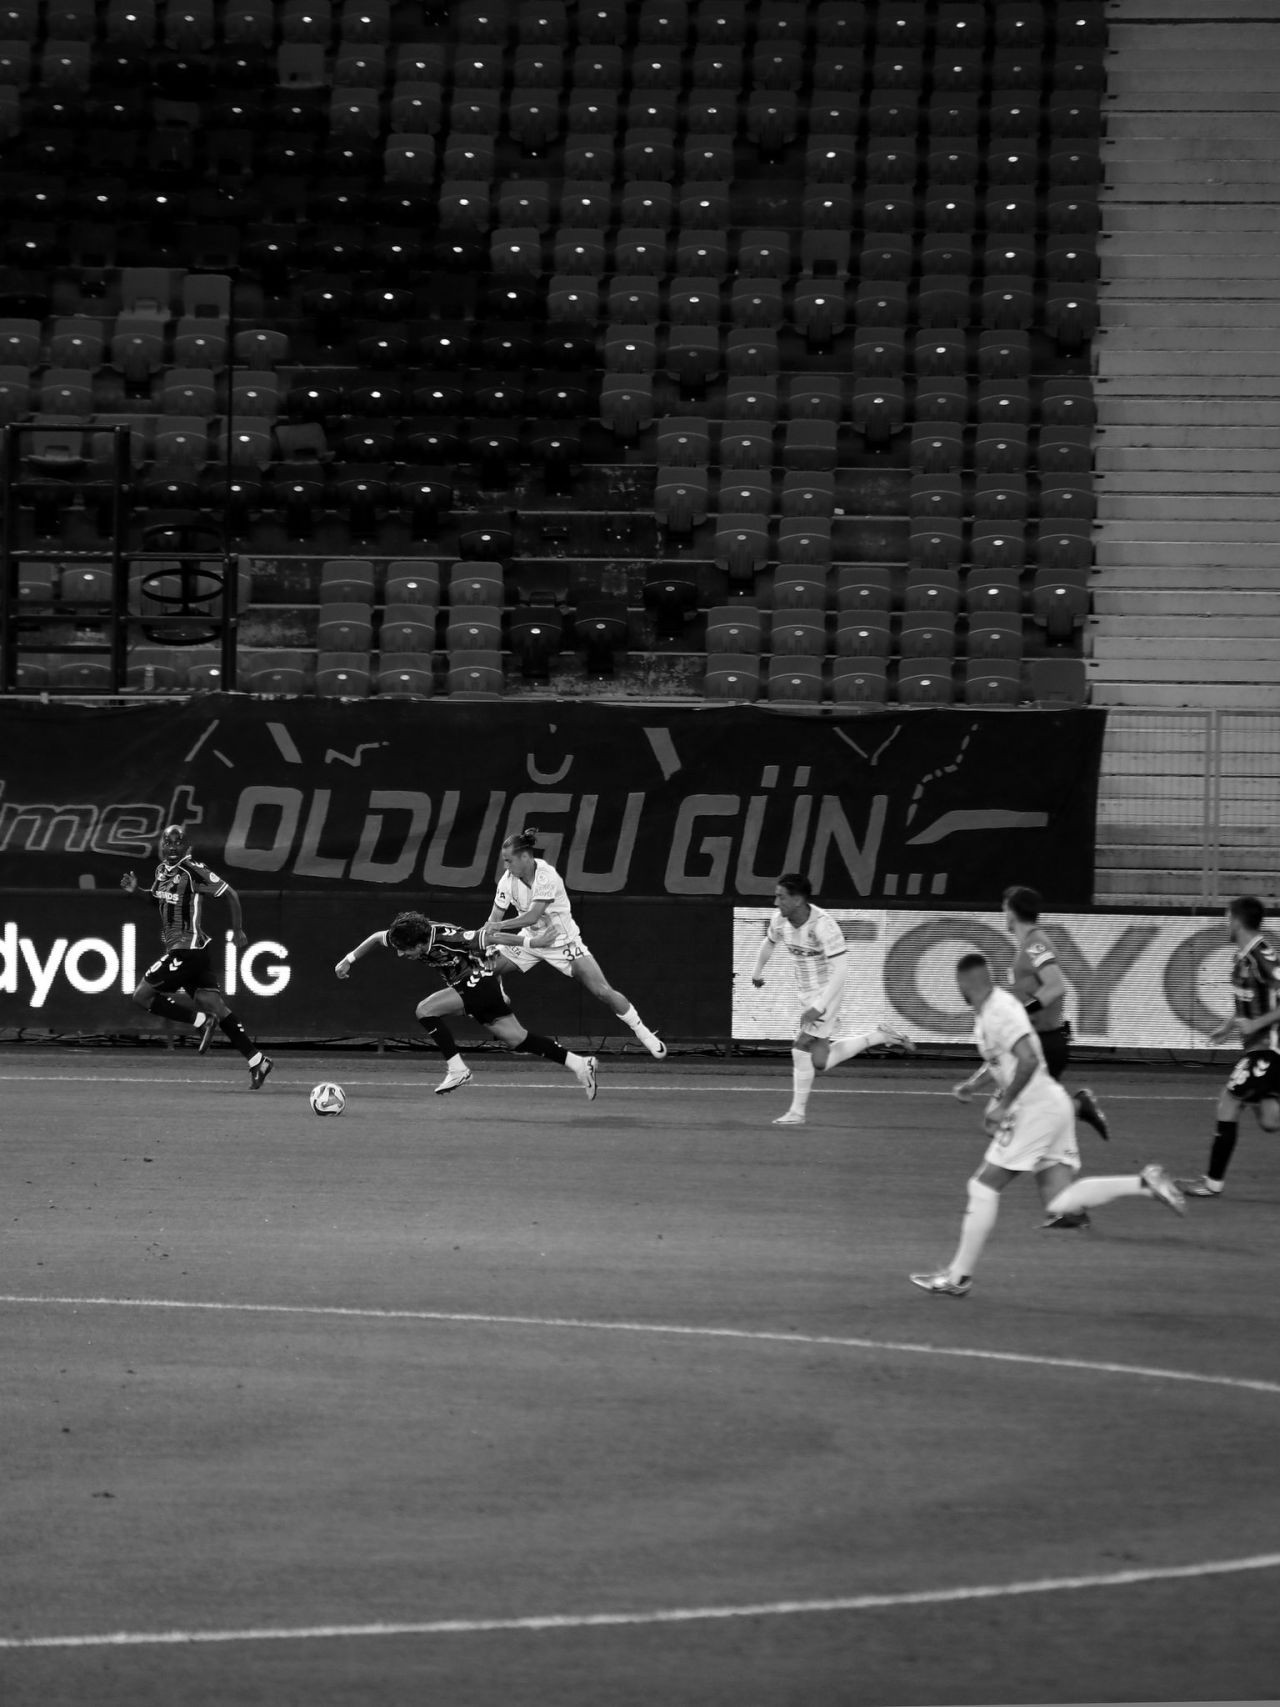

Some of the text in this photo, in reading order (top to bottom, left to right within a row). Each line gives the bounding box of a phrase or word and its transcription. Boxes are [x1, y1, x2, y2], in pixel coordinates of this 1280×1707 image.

[0, 779, 203, 860] met
[224, 753, 646, 894] OLDUĞU
[563, 945, 585, 962] 34
[765, 917, 1280, 1038] OYO
